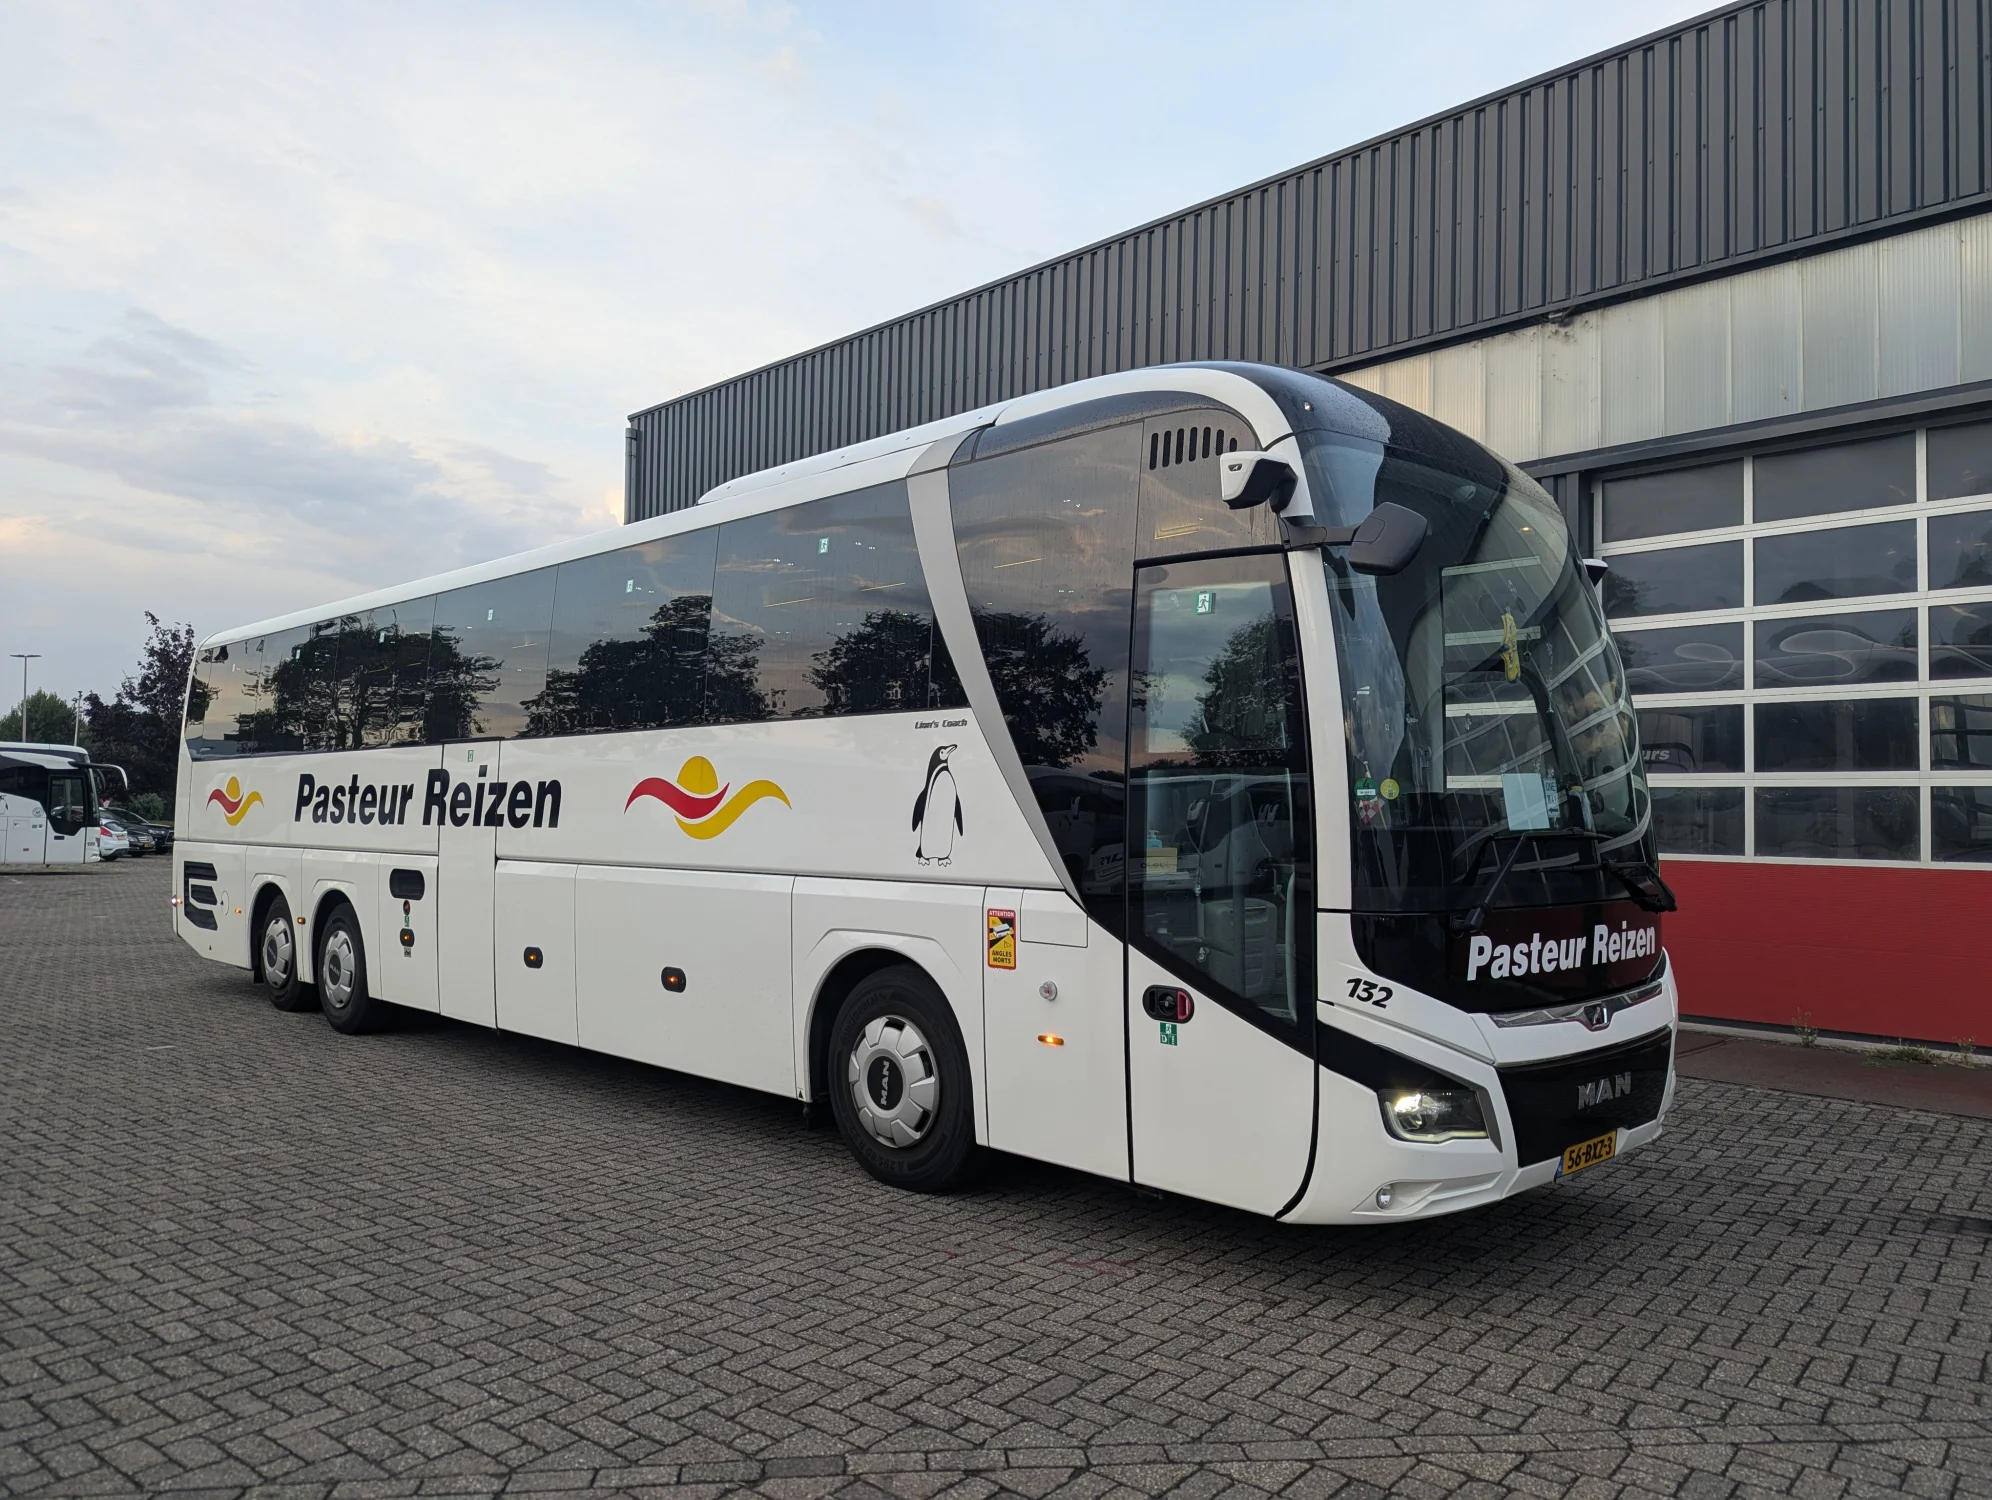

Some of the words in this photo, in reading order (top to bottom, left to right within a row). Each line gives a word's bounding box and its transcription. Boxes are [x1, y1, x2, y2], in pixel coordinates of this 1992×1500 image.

[915, 720, 939, 729] Lion's
[942, 718, 967, 727] Coach
[294, 773, 414, 825] Pasteur
[422, 765, 562, 828] Reizen
[991, 950, 1012, 958] ANGLES
[1467, 932, 1587, 981] Pasteur
[1592, 920, 1656, 965] Reizen
[1346, 978, 1394, 1009] 132
[880, 1061, 890, 1106] MAN
[1577, 1071, 1631, 1110] MAN
[1567, 1136, 1613, 1170] 56-BXZ-3
